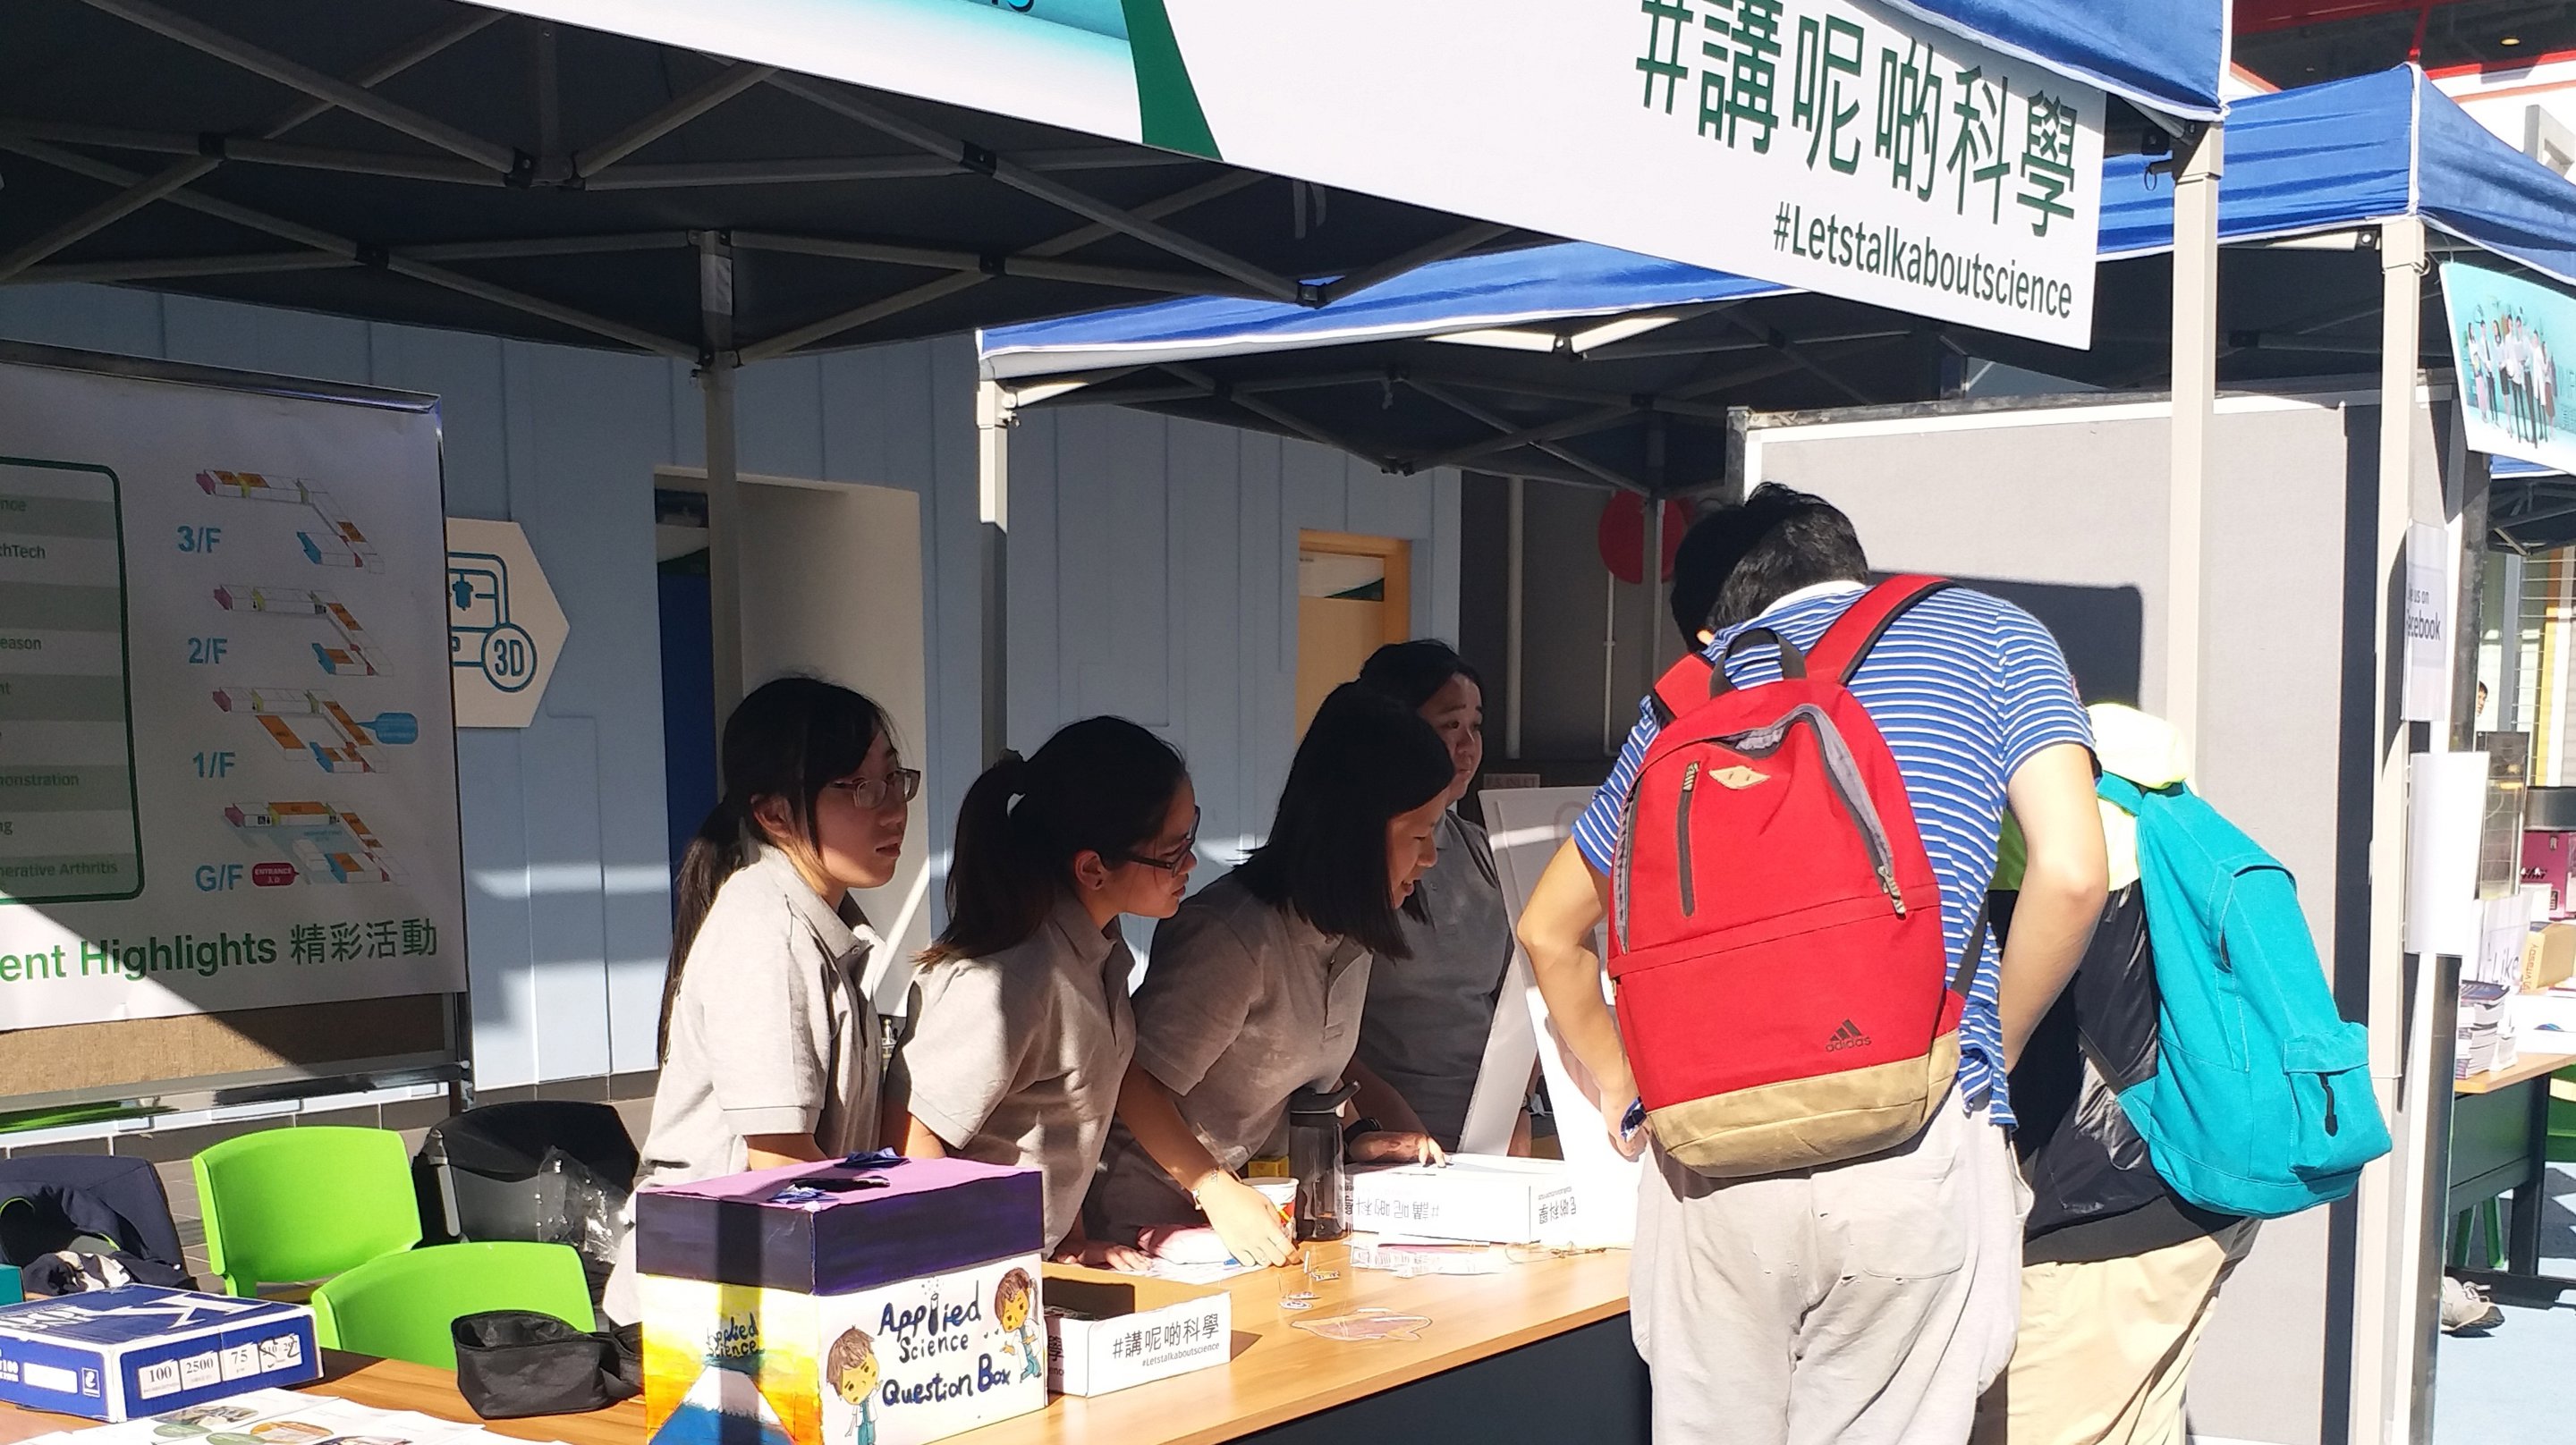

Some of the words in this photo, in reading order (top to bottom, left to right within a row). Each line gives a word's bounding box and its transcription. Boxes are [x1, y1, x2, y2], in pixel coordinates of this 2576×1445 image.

[1774, 201, 2072, 319] #Letstalkaboutscience
[176, 525, 221, 553] 3/F
[187, 637, 228, 664] 2/F
[494, 638, 525, 677] 3D
[192, 751, 236, 778] 1/F
[59, 860, 119, 875] Arthritis
[195, 864, 244, 892] G/F
[291, 917, 437, 966] 精彩活動
[80, 932, 278, 981] Highlights
[1826, 1036, 1872, 1052] adidas
[877, 1280, 982, 1342] Applied
[899, 1334, 969, 1364] Science
[1112, 1314, 1219, 1360] #講呢啲科學
[186, 1357, 214, 1374] 2500
[231, 1349, 249, 1365] 75
[1142, 1342, 1220, 1367] #Letstalkaboutscience
[149, 1366, 173, 1382] 100
[882, 1372, 974, 1407] Question
[978, 1353, 1012, 1392] Box
